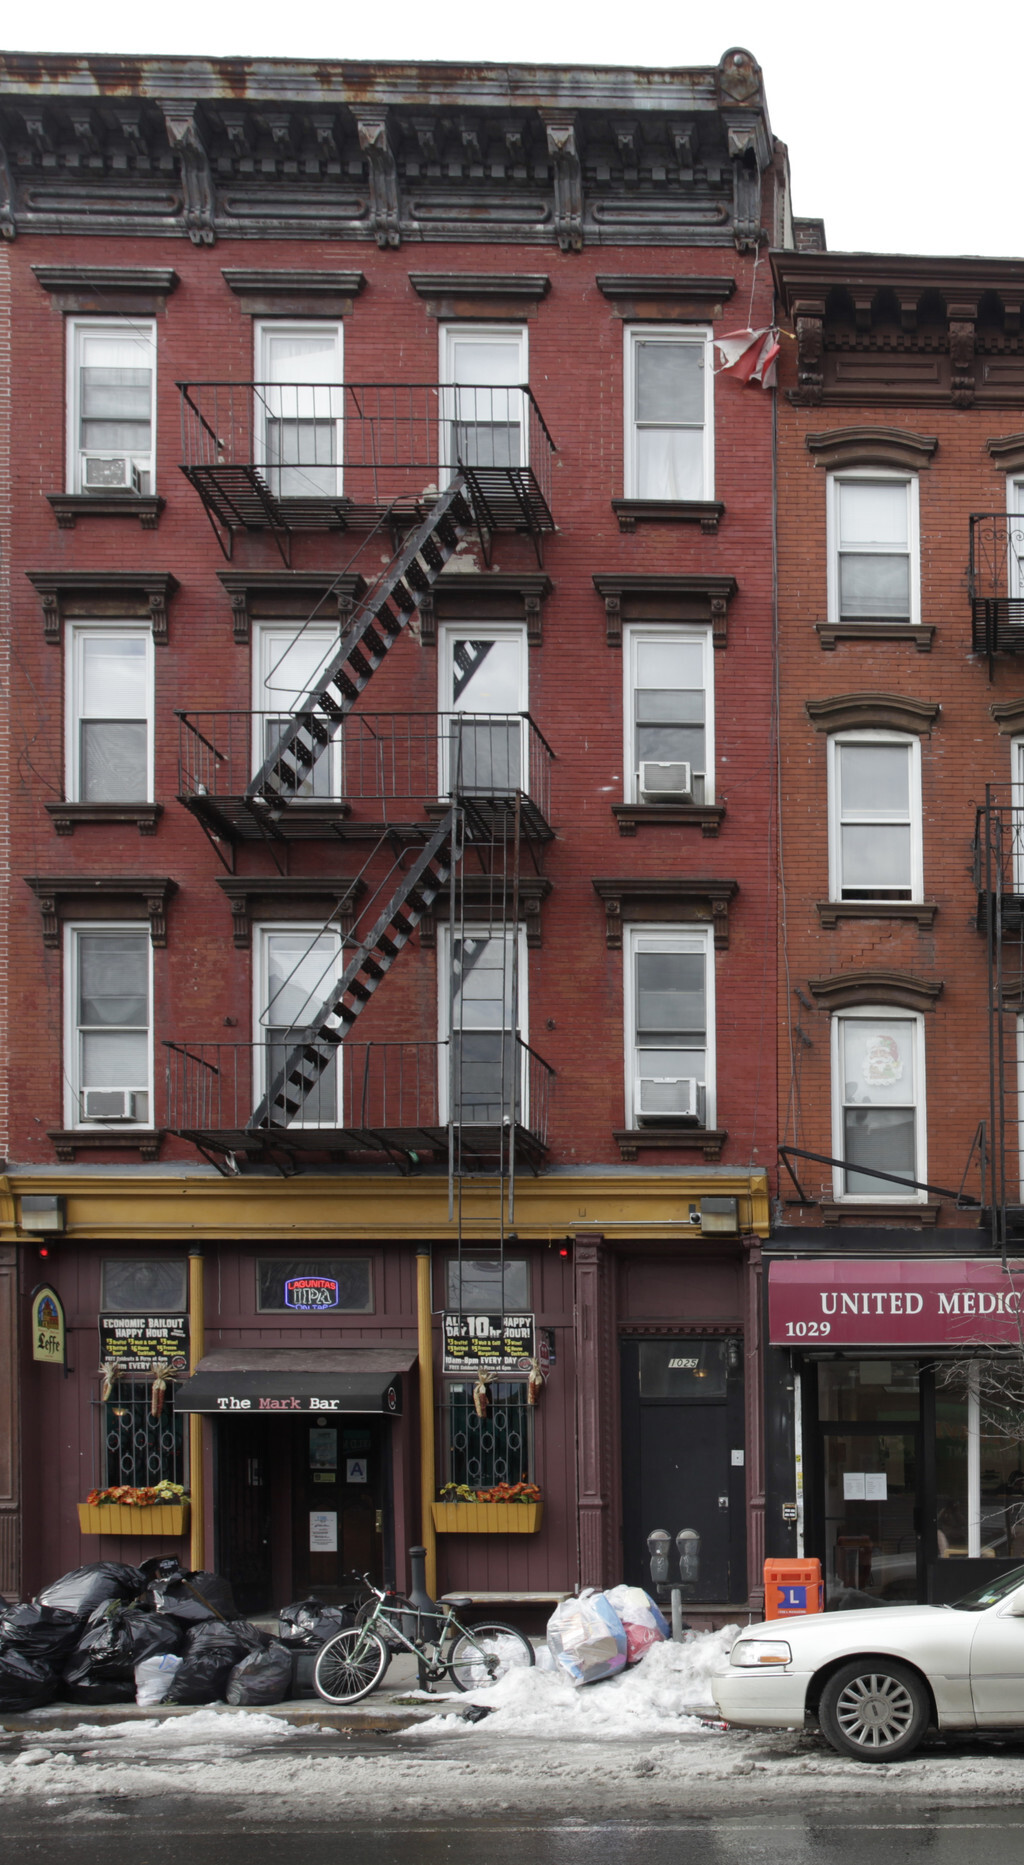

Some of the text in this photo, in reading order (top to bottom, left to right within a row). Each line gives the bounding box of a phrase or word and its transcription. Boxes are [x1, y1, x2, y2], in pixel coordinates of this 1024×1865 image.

[288, 1280, 336, 1290] LAGUNITAS
[294, 1288, 332, 1304] IPA
[820, 1292, 924, 1314] UNITED
[103, 1318, 184, 1328] ECONOMIC BAILOUT
[786, 1322, 831, 1336] 1029
[115, 1328, 143, 1338] HAPPY
[146, 1328, 168, 1338] HOUR
[503, 1328, 530, 1338] HOUR!
[38, 1333, 60, 1354] Leffe
[217, 1397, 339, 1409] The Mark Bar
[350, 1462, 363, 1476] A
[790, 1590, 799, 1604] L
